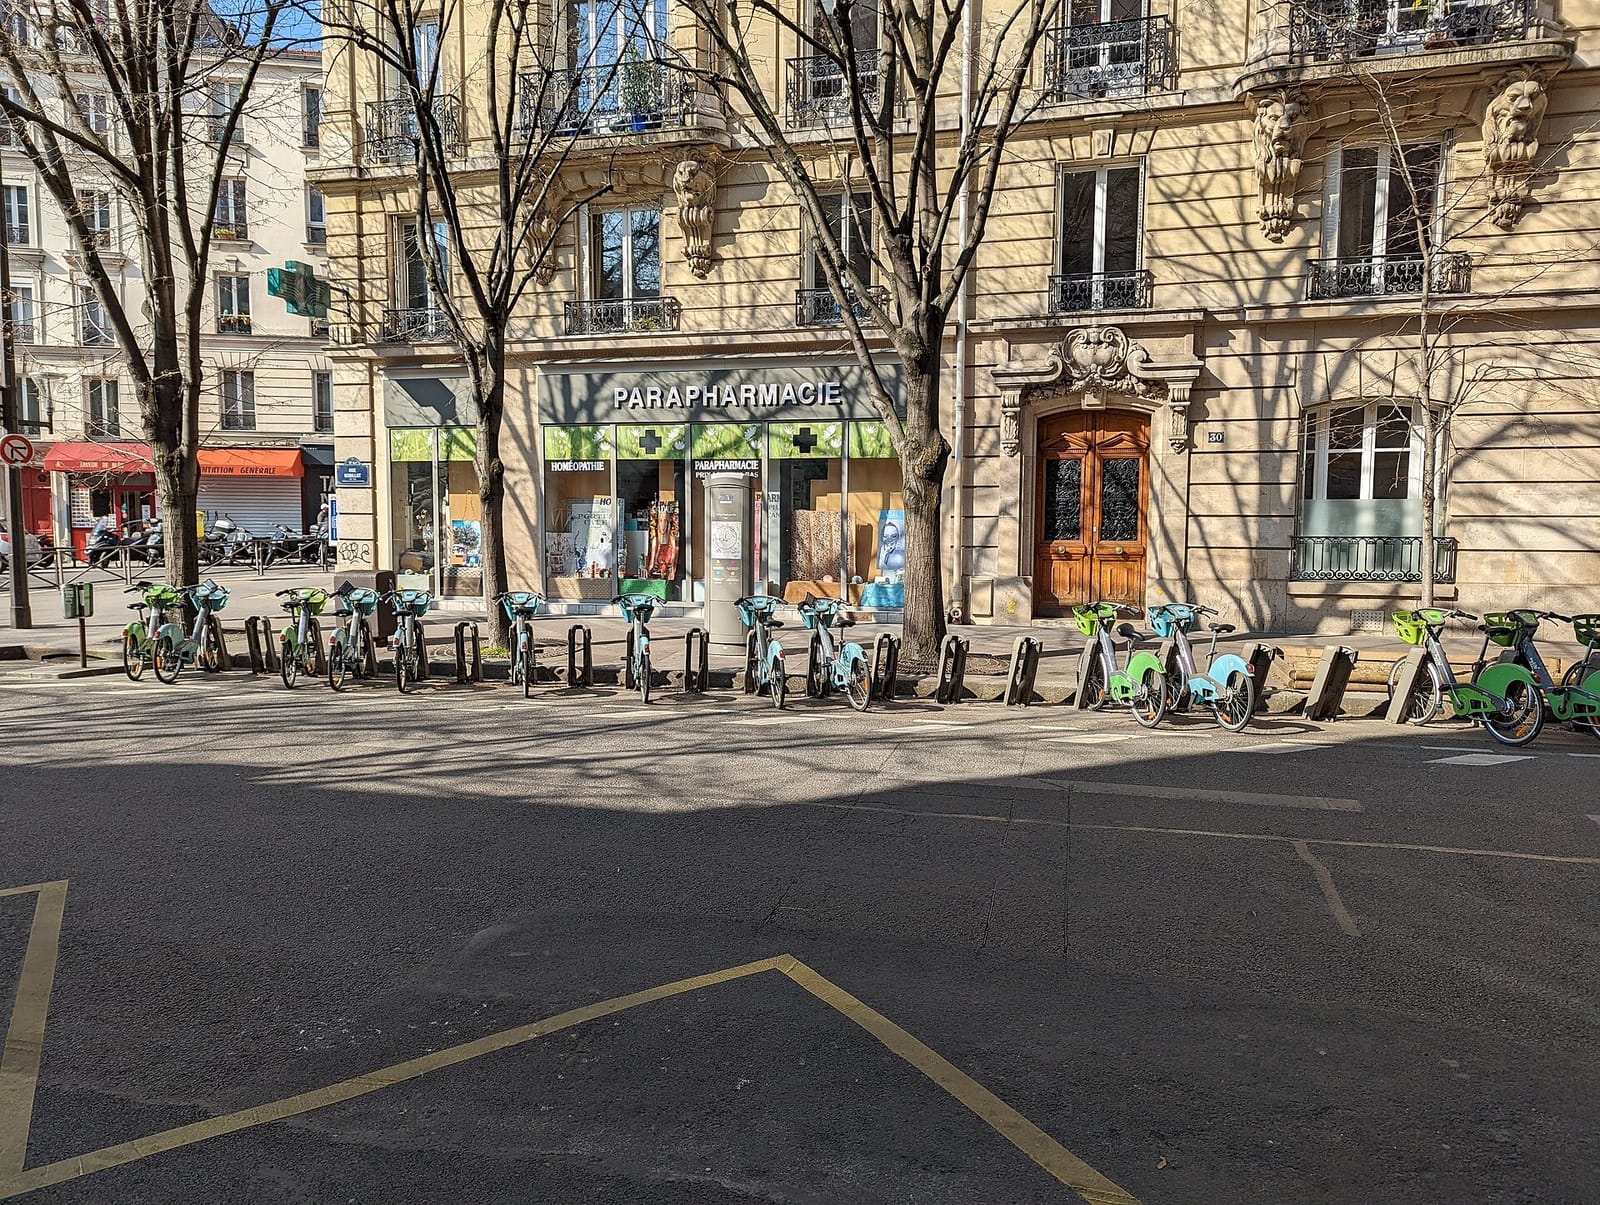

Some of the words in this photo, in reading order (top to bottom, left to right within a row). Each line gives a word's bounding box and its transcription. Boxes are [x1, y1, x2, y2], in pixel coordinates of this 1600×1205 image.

[614, 382, 841, 408] PARAPHARMACIE
[1209, 433, 1222, 442] 30
[551, 460, 605, 472] HOMÉOPATHIE
[694, 460, 760, 470] PARAPHARMACIE
